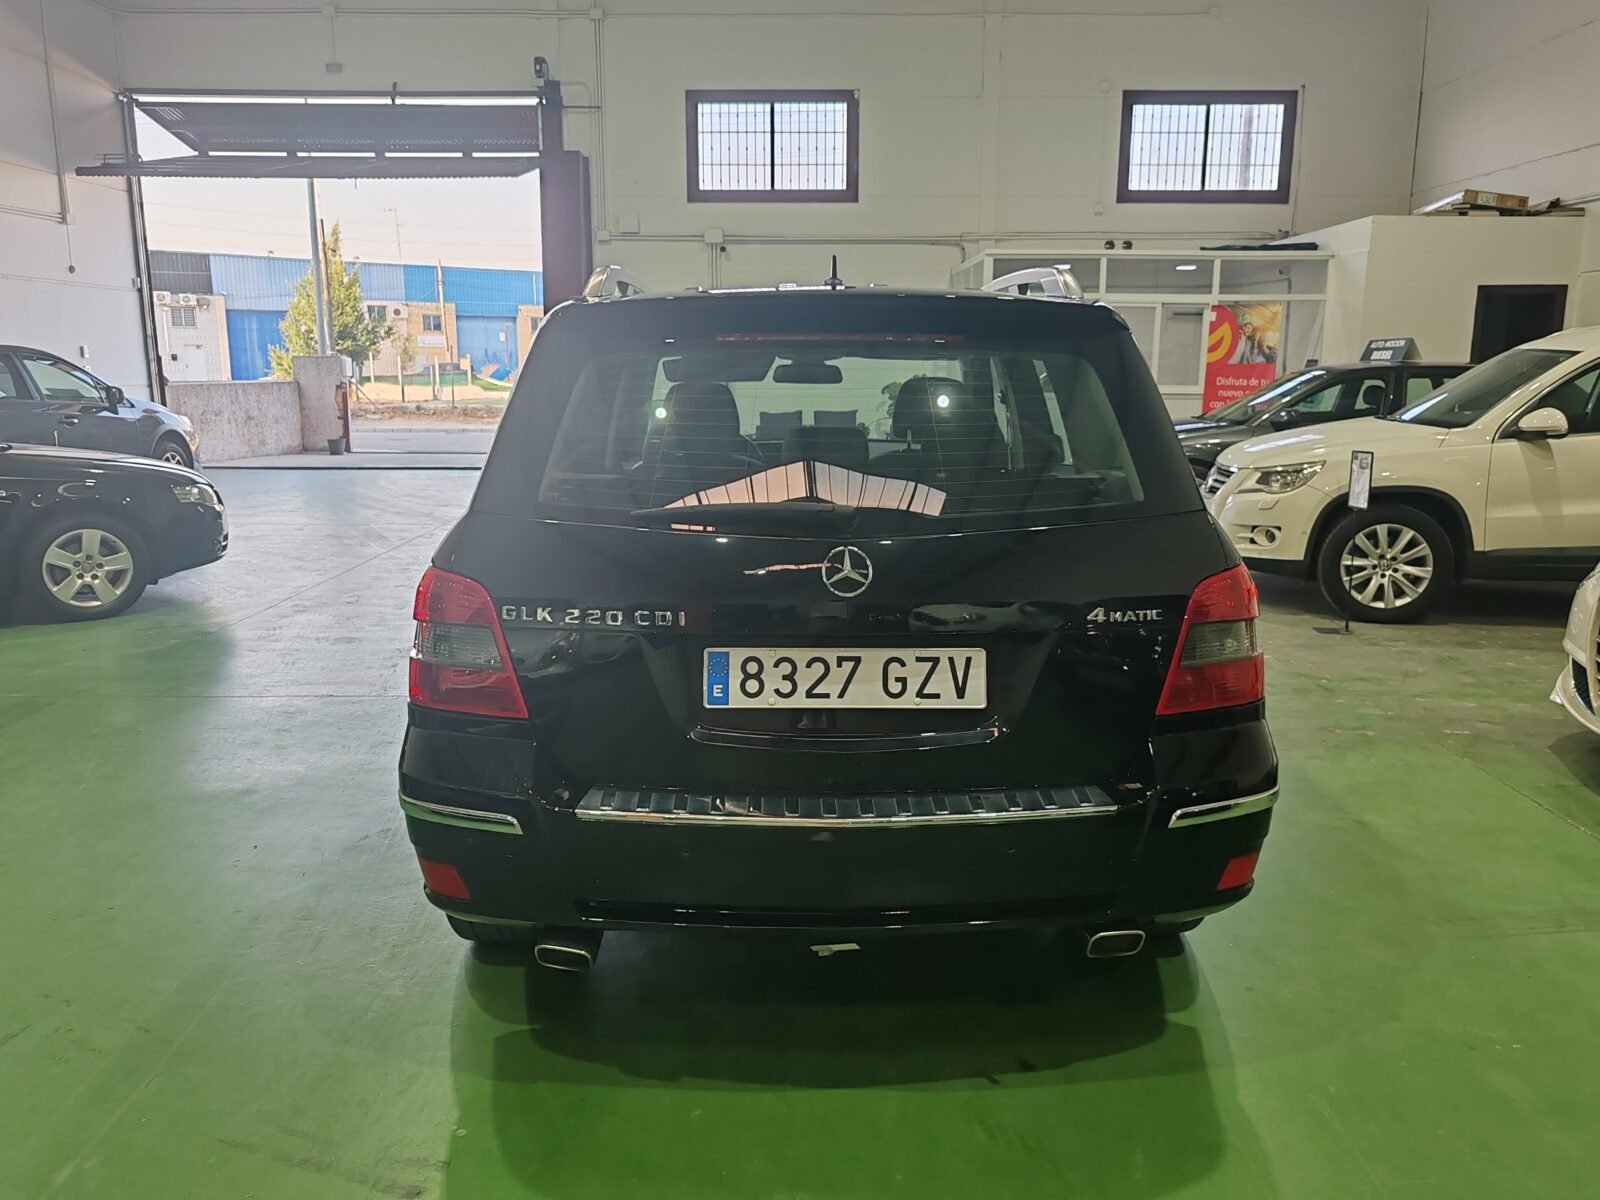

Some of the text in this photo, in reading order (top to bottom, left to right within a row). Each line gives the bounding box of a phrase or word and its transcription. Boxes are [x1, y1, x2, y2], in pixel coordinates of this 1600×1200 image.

[1216, 376, 1248, 386] Disfruta
[1249, 376, 1260, 386] de
[1218, 389, 1244, 397] nuevo
[1209, 400, 1225, 408] con
[501, 604, 686, 627] GLK 220 CDI
[1086, 607, 1163, 623] 4MATIC
[739, 655, 972, 699] 8327 GZV
[712, 684, 723, 697] E
